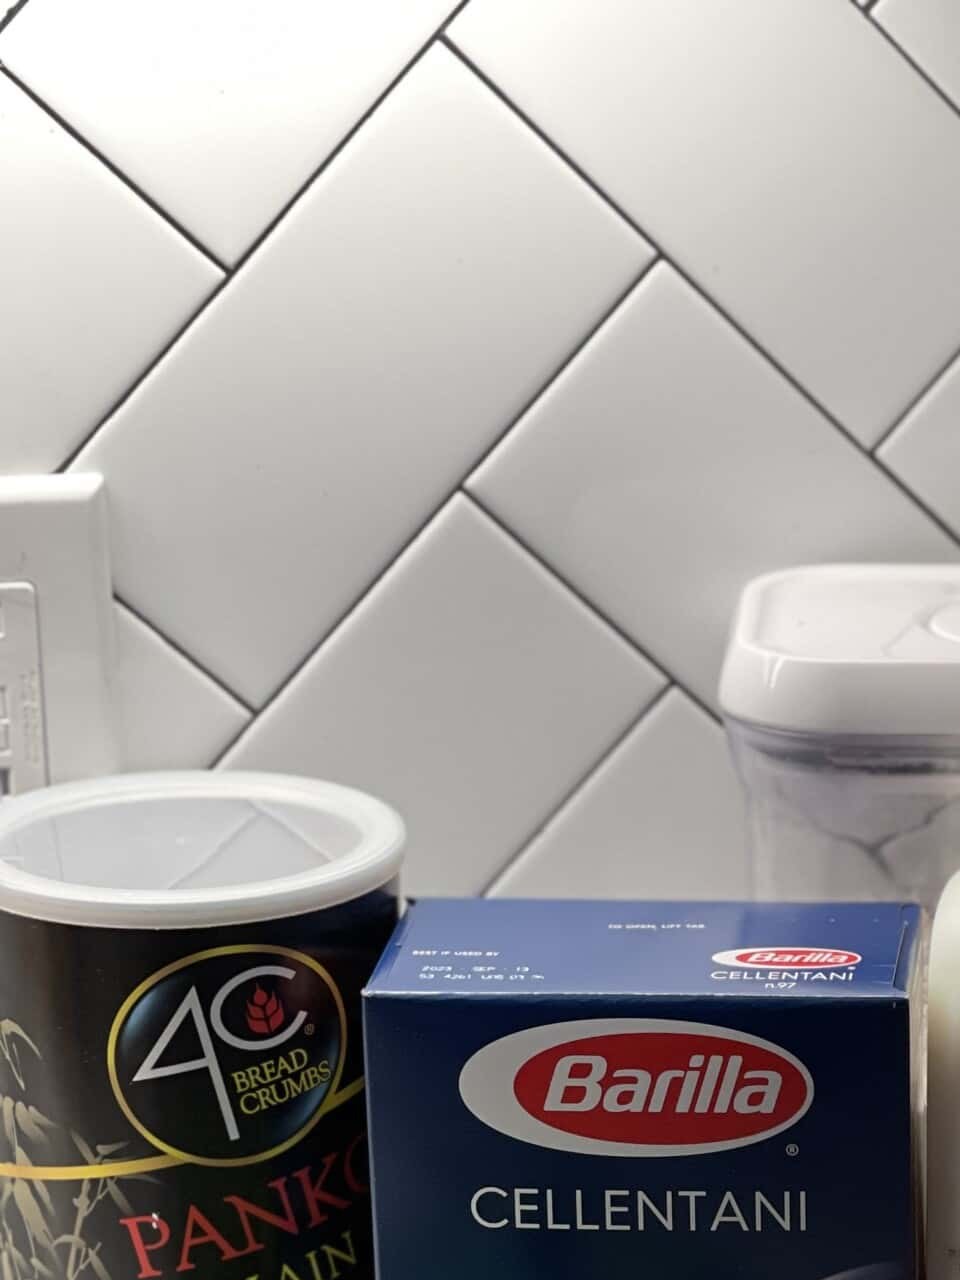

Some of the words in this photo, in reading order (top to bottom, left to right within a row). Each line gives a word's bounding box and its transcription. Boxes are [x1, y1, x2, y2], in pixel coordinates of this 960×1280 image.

[711, 970, 853, 981] CELLENTANI
[749, 952, 849, 965] Barilla
[132, 966, 308, 1141] 4C
[231, 1048, 309, 1093] BREAD
[239, 1060, 331, 1115] CRUMBS
[543, 1054, 784, 1114] Barilla
[470, 1186, 808, 1232] CELLENTANI
